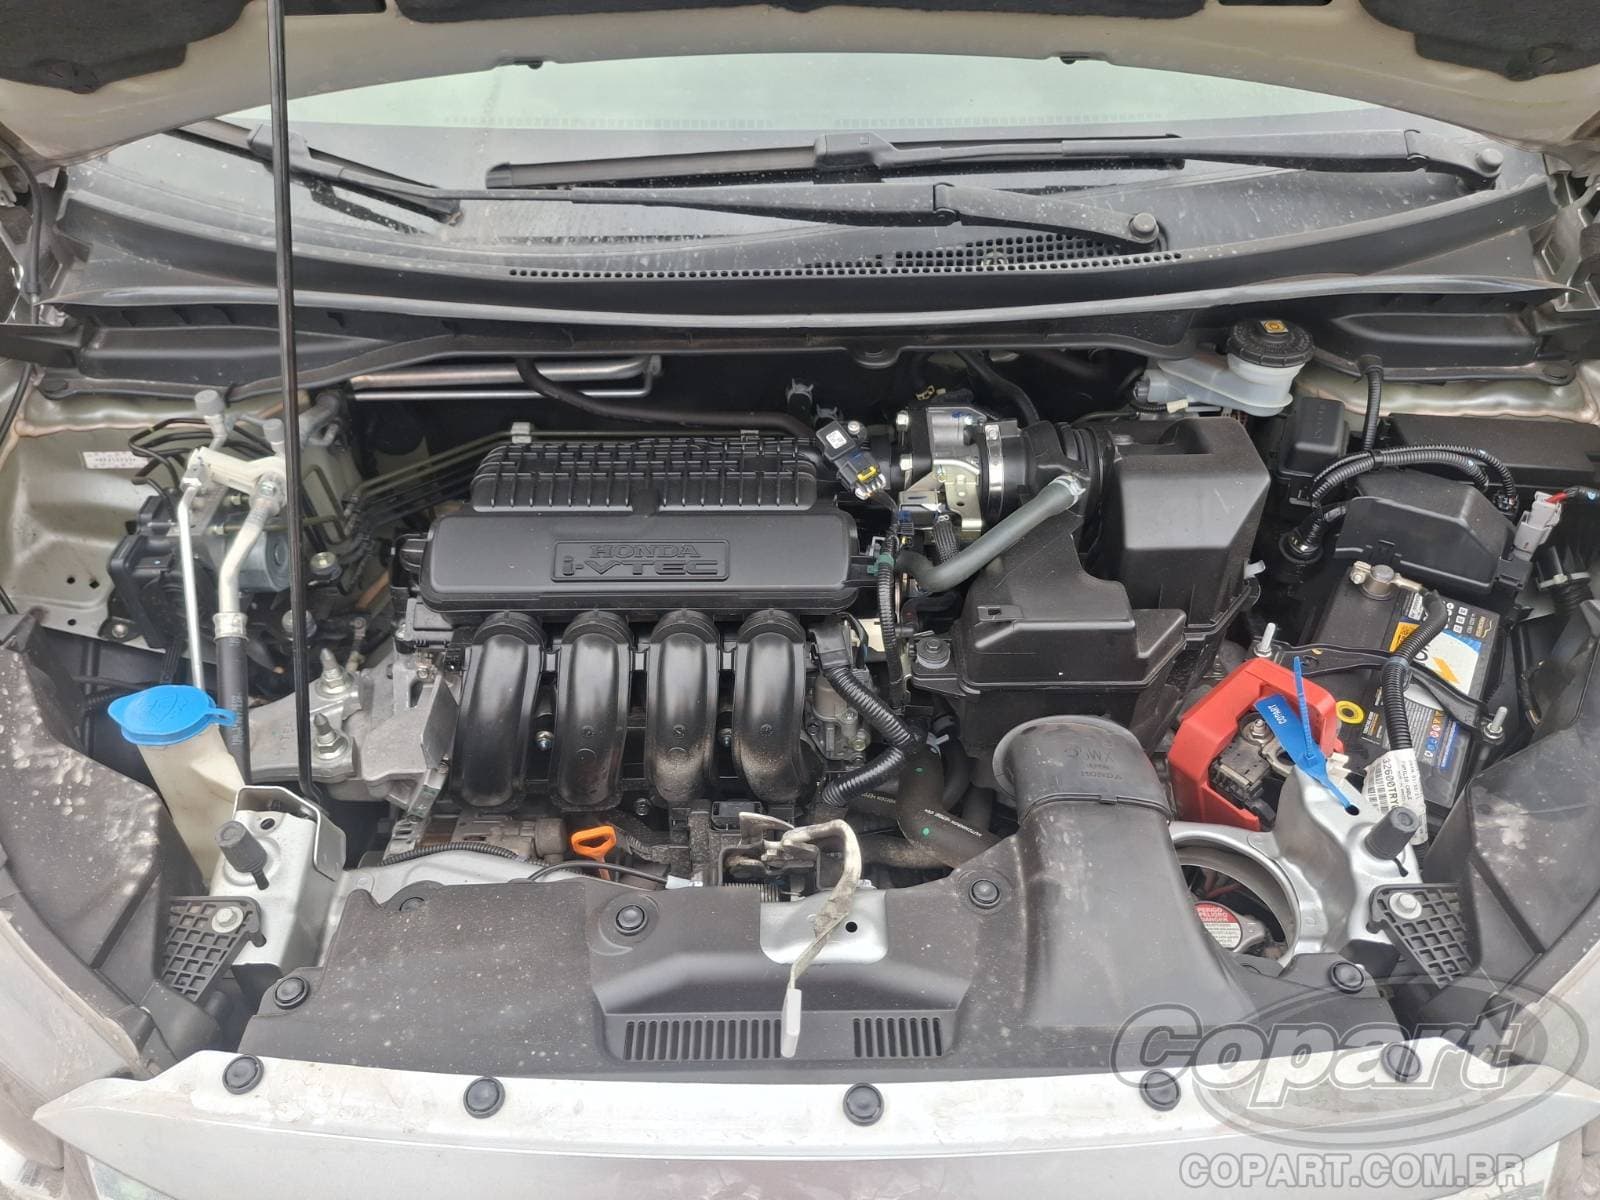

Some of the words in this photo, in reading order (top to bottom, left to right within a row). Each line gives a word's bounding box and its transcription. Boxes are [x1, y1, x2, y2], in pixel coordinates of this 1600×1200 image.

[589, 544, 702, 558] HONDA
[562, 555, 718, 576] i-VTEC
[1268, 704, 1287, 725] COPART
